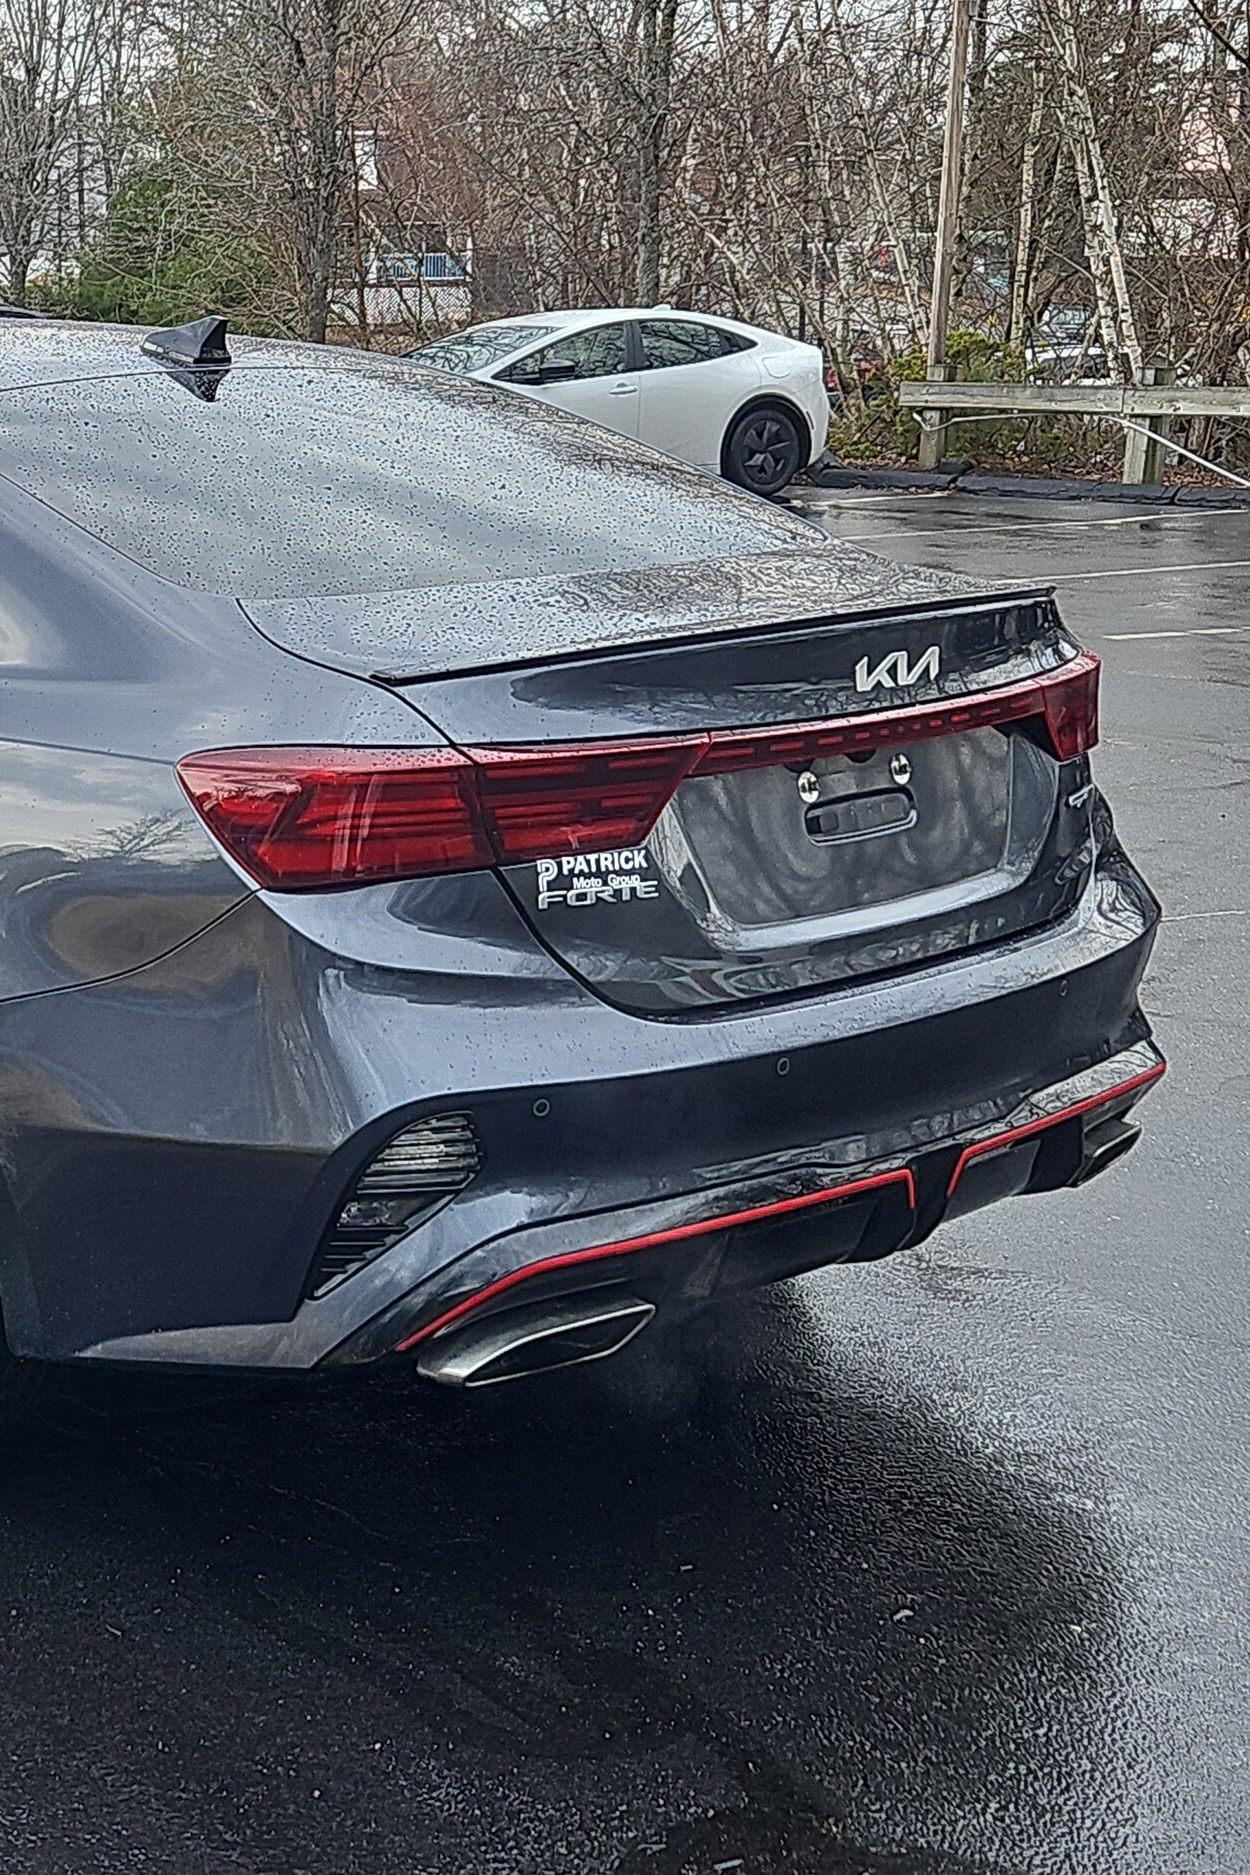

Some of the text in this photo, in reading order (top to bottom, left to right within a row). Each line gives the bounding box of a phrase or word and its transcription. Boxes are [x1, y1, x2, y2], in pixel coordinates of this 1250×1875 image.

[855, 646, 940, 692] KIA
[561, 849, 648, 875] PATRICK
[538, 880, 660, 909] FORTE
[572, 874, 641, 889] Moto Group
